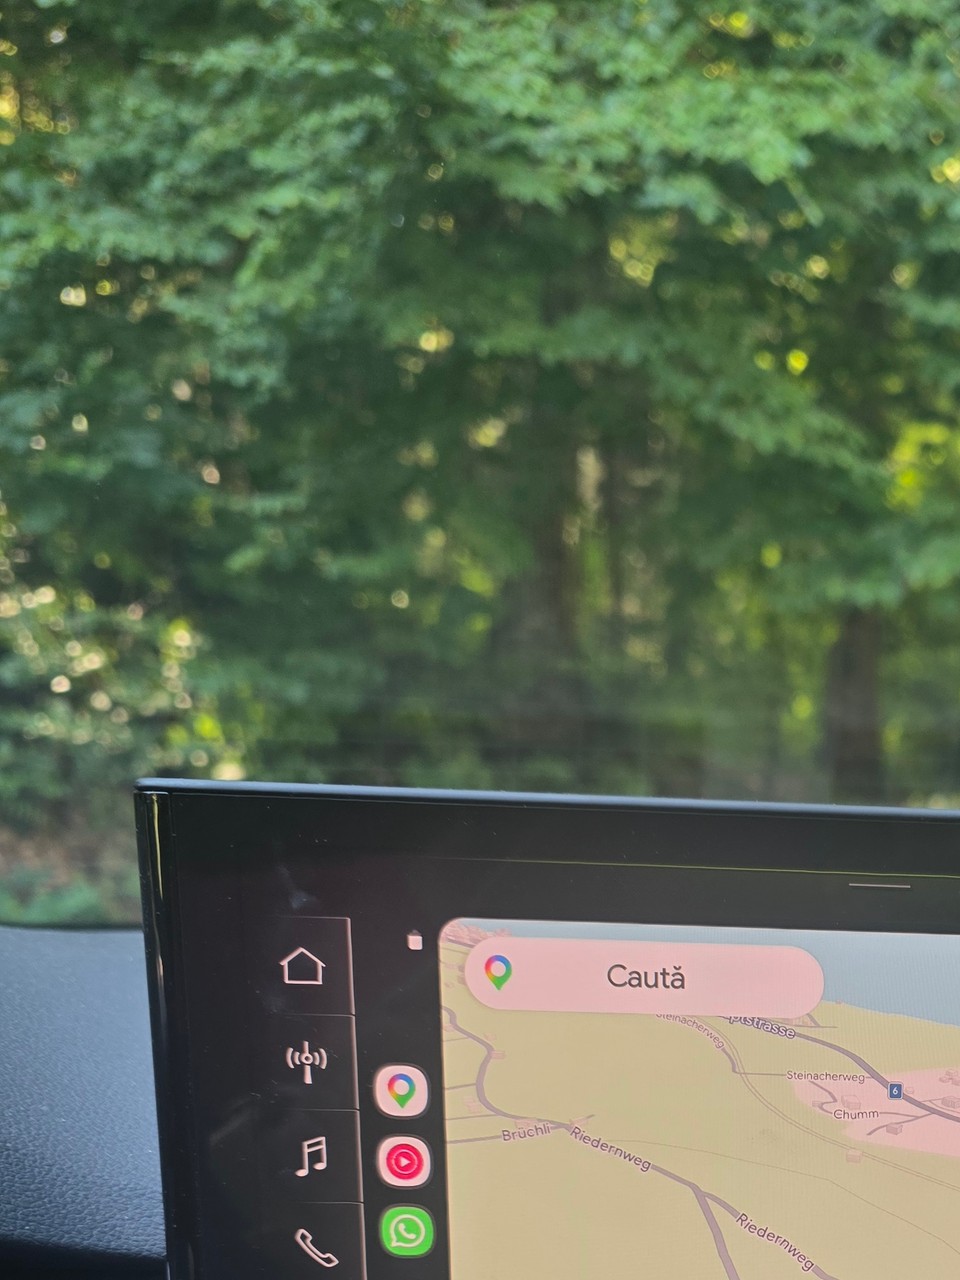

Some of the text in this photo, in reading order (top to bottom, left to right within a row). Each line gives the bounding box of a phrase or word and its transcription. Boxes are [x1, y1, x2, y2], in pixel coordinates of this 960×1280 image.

[606, 964, 686, 990] Caută
[786, 1070, 866, 1085] Steinacherweg
[891, 1085, 900, 1096] 6
[833, 1109, 879, 1120] Chumm
[501, 1123, 551, 1142] Brüchli
[570, 1126, 651, 1172] Riedernweg
[735, 1212, 815, 1272] Riedernweg
